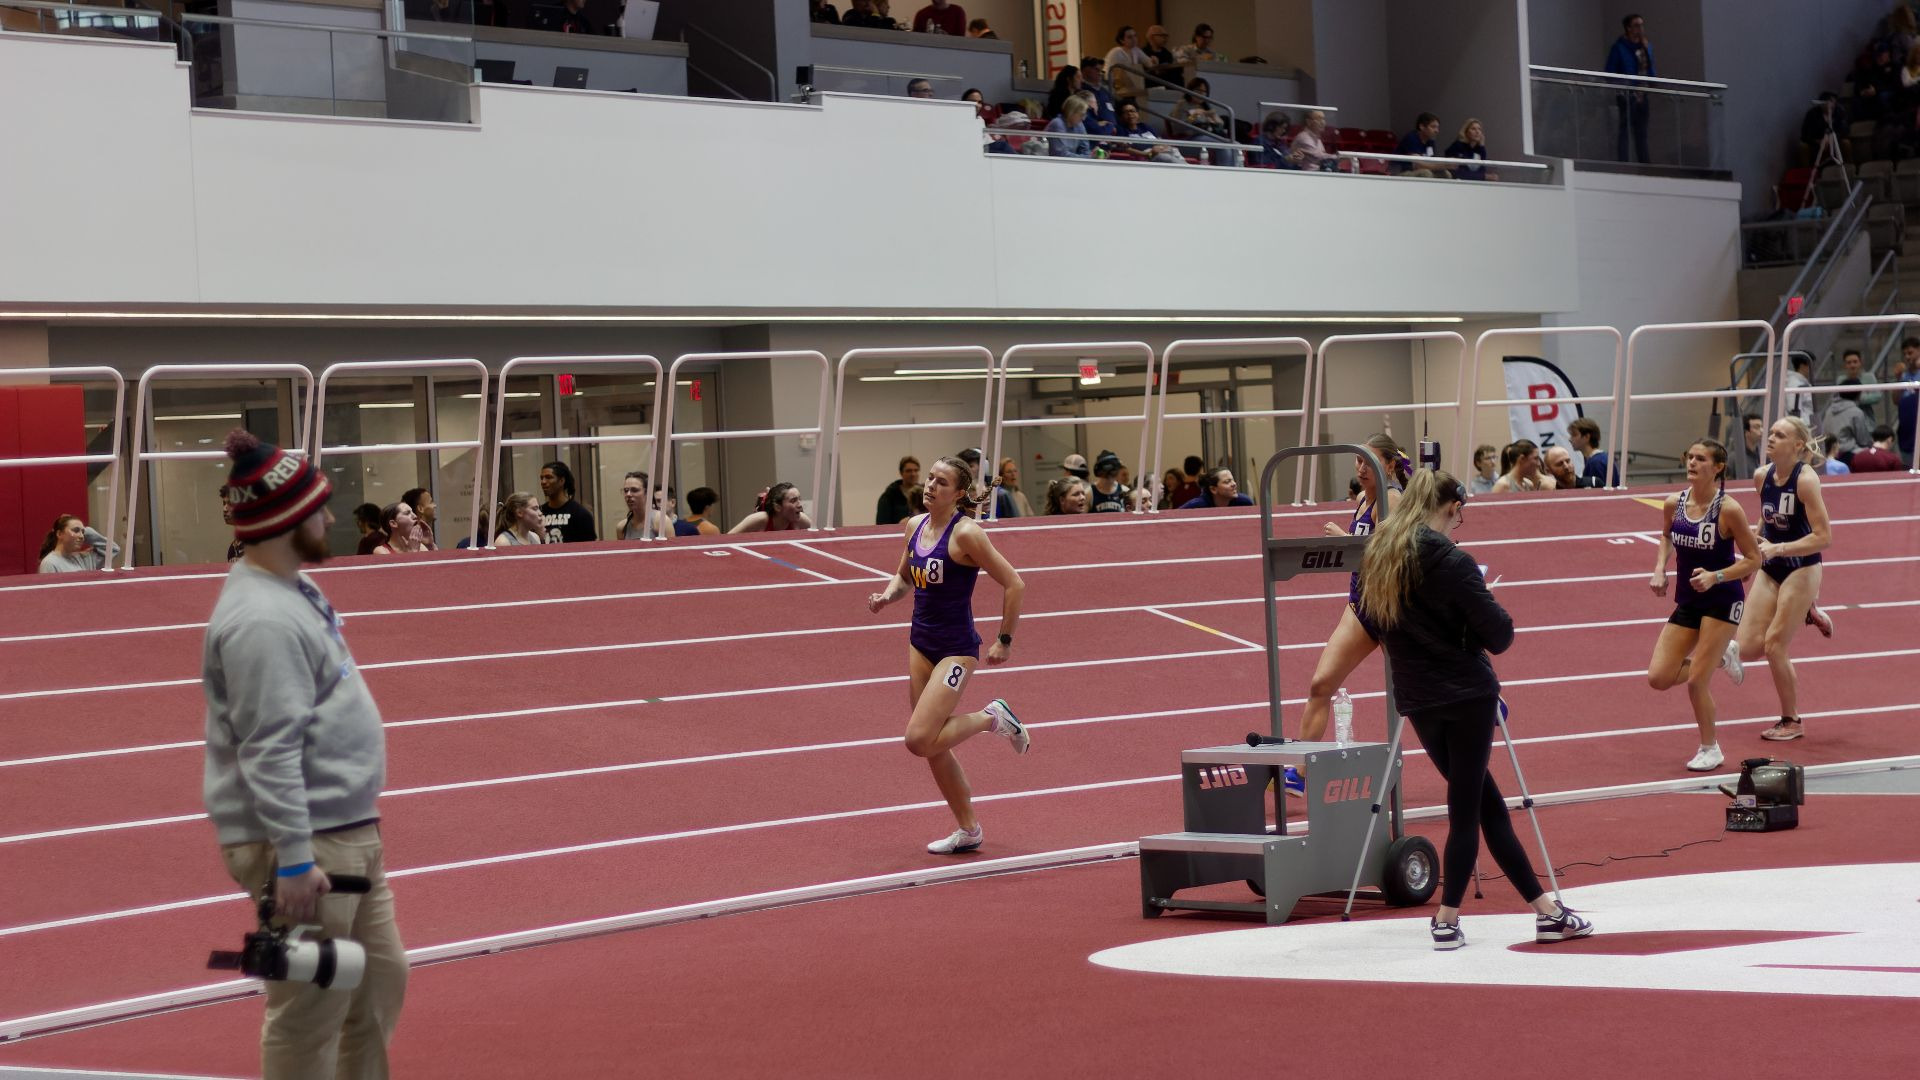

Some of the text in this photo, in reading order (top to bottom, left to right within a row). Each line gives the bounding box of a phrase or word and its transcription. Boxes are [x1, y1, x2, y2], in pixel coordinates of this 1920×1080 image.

[1528, 383, 1559, 422] B
[229, 456, 301, 504] OX RED
[1784, 495, 1791, 514] 1
[543, 513, 571, 526] OLLY
[1358, 524, 1366, 535] 7
[1701, 525, 1712, 544] 6
[1302, 551, 1344, 569] GILL
[928, 560, 940, 583] 8
[1734, 601, 1742, 620] 6
[947, 665, 963, 688] 8
[1323, 776, 1372, 804] GILL
